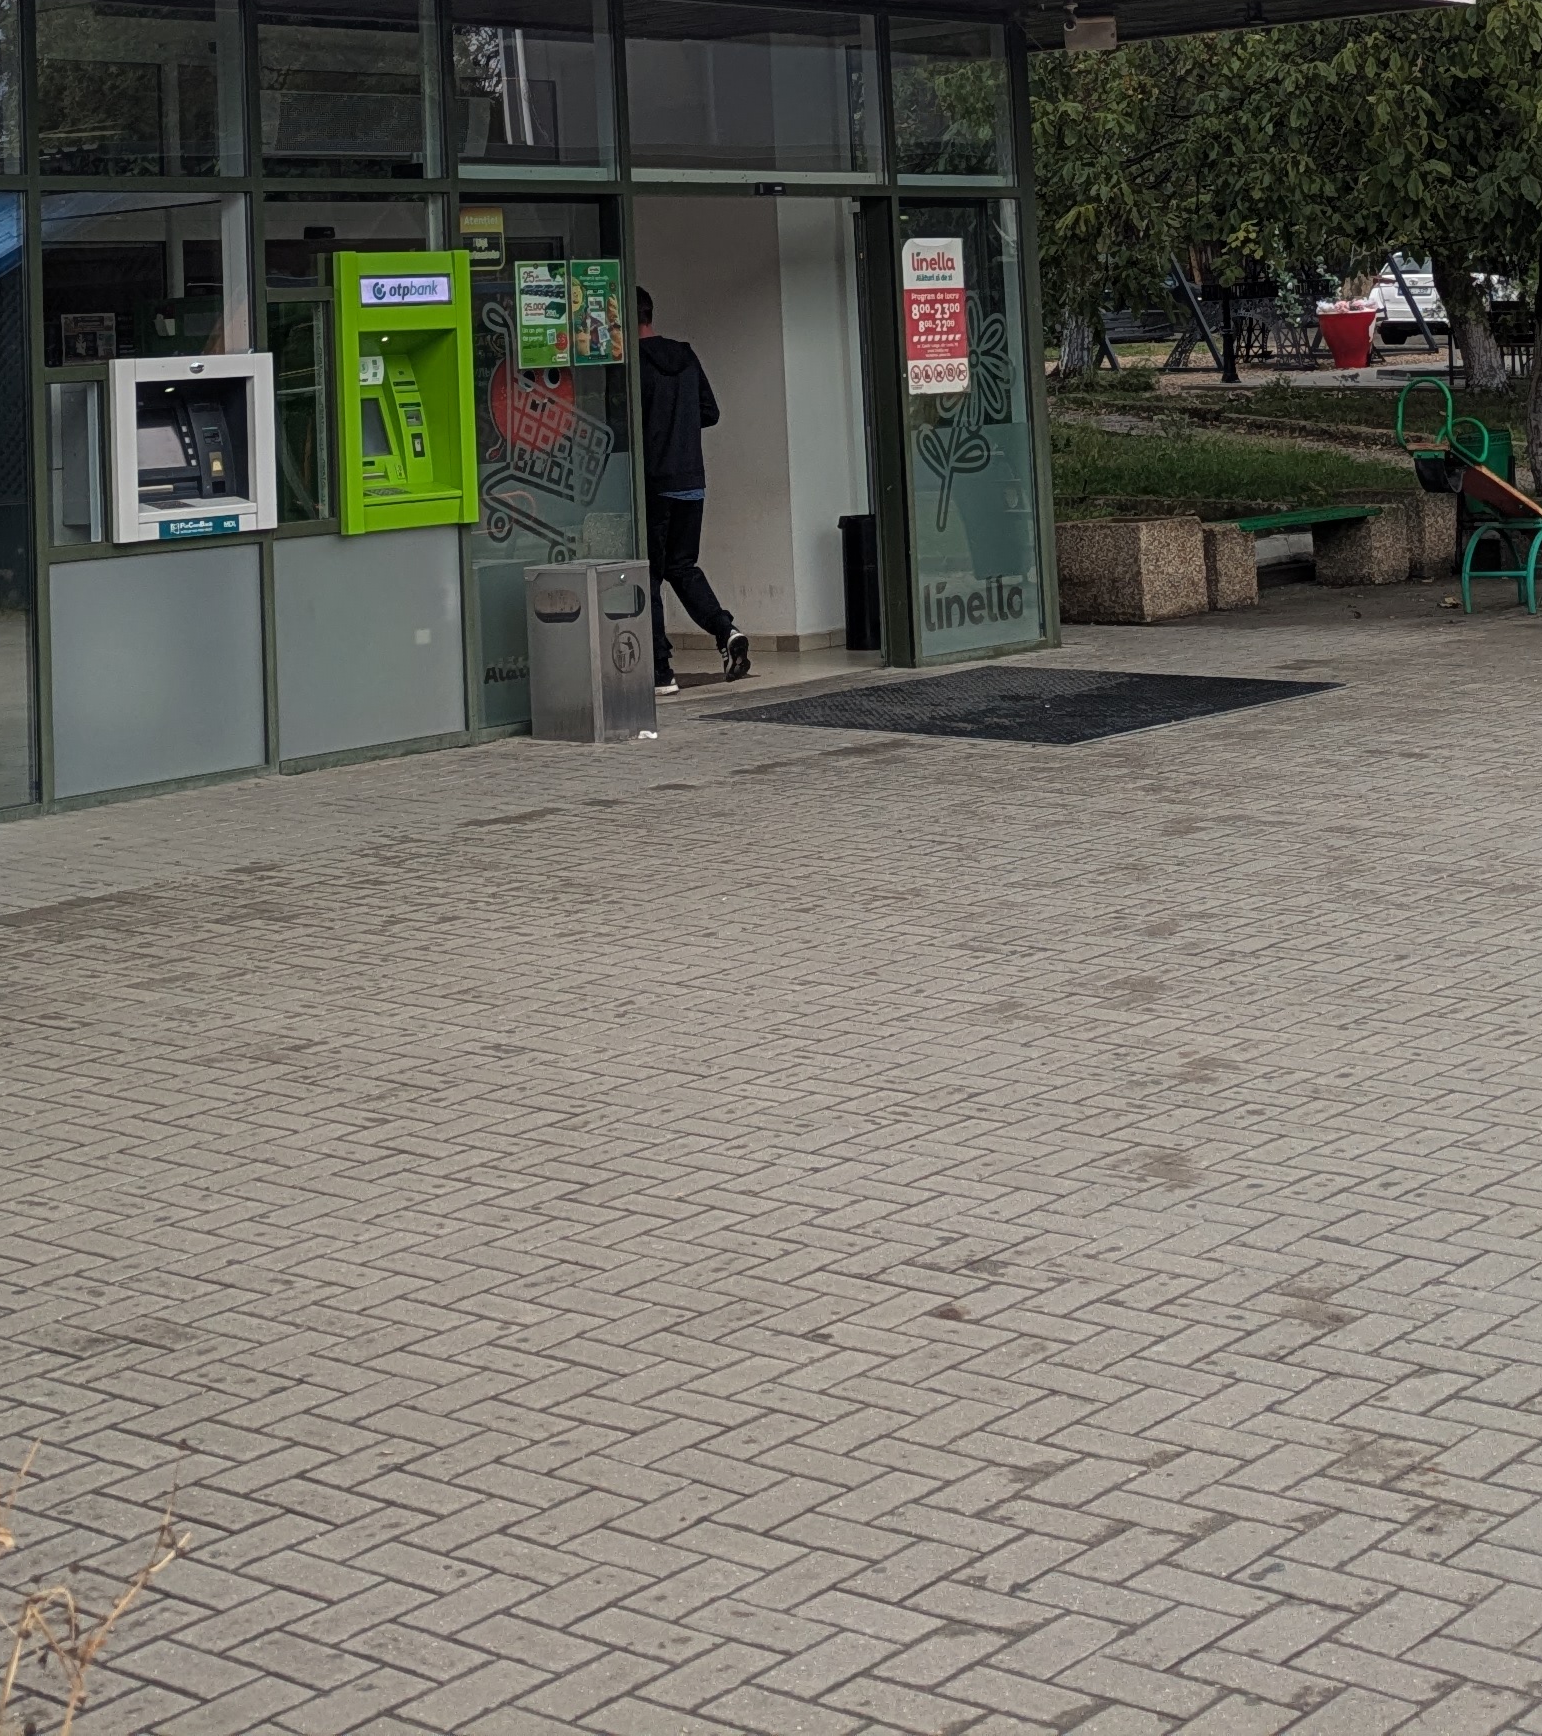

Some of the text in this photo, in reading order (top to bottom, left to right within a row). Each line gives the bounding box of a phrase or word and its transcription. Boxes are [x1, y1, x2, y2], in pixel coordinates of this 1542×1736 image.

[911, 251, 956, 272] linella
[911, 293, 935, 302] Program
[945, 292, 960, 300] lucru
